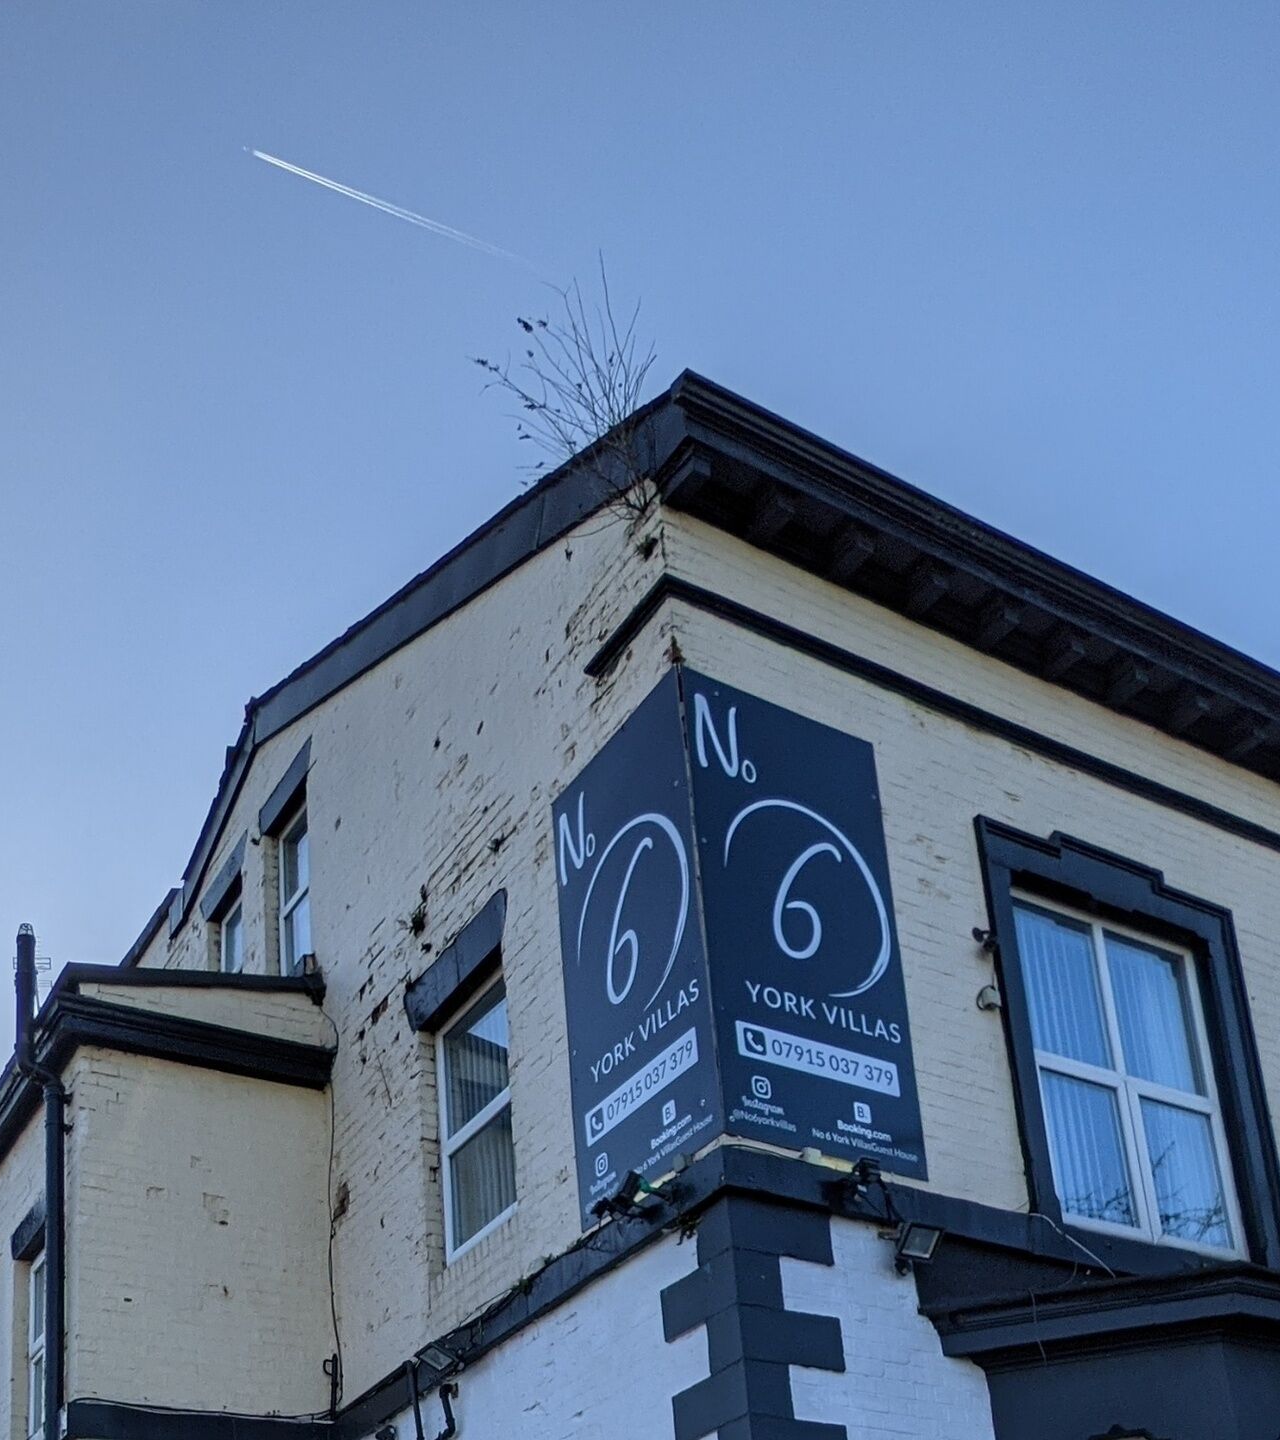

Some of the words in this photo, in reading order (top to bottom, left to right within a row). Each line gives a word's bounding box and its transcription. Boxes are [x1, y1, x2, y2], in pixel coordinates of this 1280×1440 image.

[694, 692, 758, 784] No
[558, 790, 596, 887] No
[606, 836, 654, 1006] 6
[772, 842, 842, 960] 6
[590, 1031, 636, 1083] YORK
[638, 977, 701, 1042] VILLAS
[745, 980, 817, 1021] YORK
[821, 1002, 902, 1045] VILLAS
[606, 1079, 644, 1121] 07915
[644, 1059, 668, 1091] 037
[669, 1039, 694, 1072] 379
[771, 1039, 826, 1068] 07915
[828, 1054, 861, 1078] 037
[863, 1065, 895, 1087] 379
[650, 1113, 693, 1150] Booking.com
[811, 1127, 825, 1140] No
[825, 1131, 831, 1141] 6
[831, 1132, 850, 1146] York
[893, 1147, 919, 1163] House
[836, 1119, 893, 1143] Booking.com
